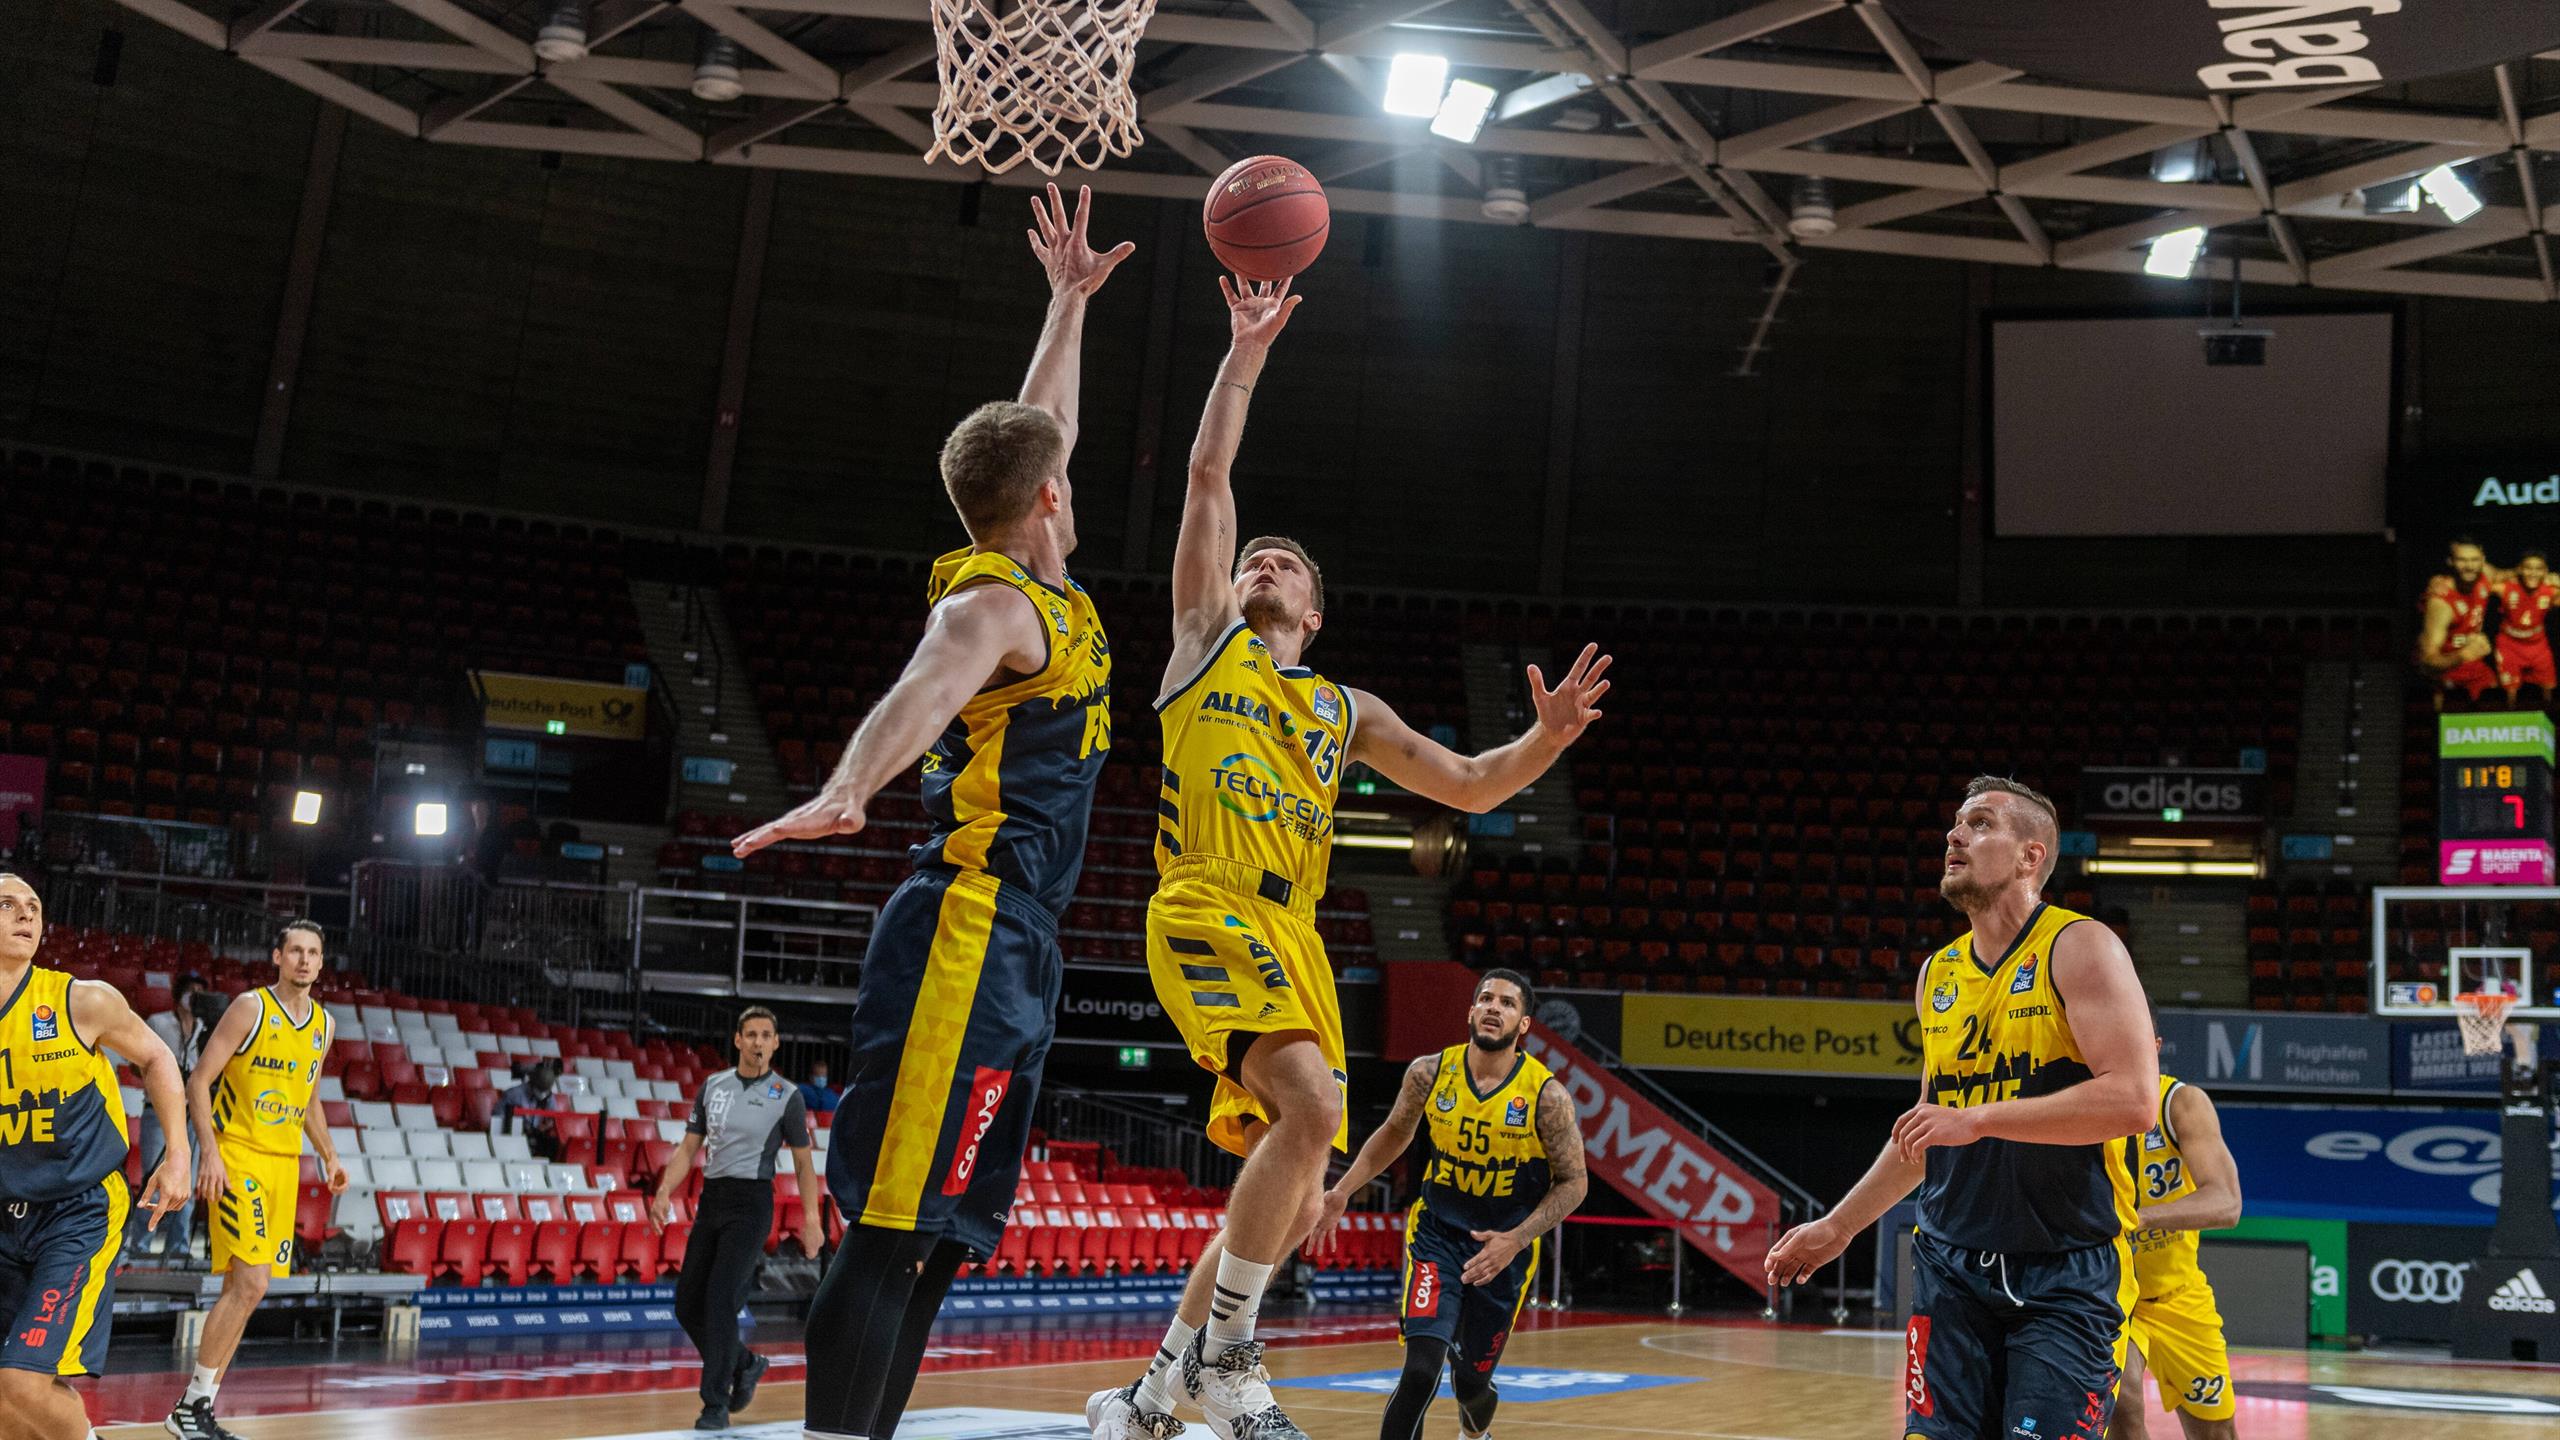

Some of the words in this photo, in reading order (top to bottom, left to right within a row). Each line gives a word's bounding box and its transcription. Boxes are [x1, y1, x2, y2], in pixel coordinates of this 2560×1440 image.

[1200, 690, 1271, 728] ALBA
[1315, 706, 1336, 723] BBL
[2445, 725, 2541, 745] BARMER
[1303, 729, 1340, 786] 15
[2103, 776, 2243, 811] adidas
[2502, 794, 2526, 830] 7
[2479, 848, 2544, 863] MAGENTA
[2480, 862, 2523, 874] SPORT
[2013, 981, 2032, 993] BBL
[1063, 994, 1161, 1022] Lounge
[2008, 1005, 2052, 1020] VIEROL
[35, 1029, 56, 1039] BBL
[1663, 1023, 1805, 1053] Deutsche
[1814, 1027, 1880, 1057] Post
[1957, 1010, 1993, 1061] 24
[32, 1048, 79, 1064] VIEROL
[250, 1055, 285, 1071] ALBA
[2285, 1041, 2368, 1064] Flughafen
[306, 1059, 319, 1085] 8
[2284, 1064, 2361, 1083] München
[1506, 1116, 1526, 1126] BBL
[1456, 1115, 1493, 1156] 55
[1525, 1033, 1756, 1253] RMER
[1433, 1160, 1517, 1198] EWE
[2143, 1156, 2184, 1200] 32
[251, 1196, 267, 1239] ALBA
[275, 1239, 292, 1265] 8
[2487, 1295, 2557, 1315] adidas
[2183, 1374, 2226, 1407] 32
